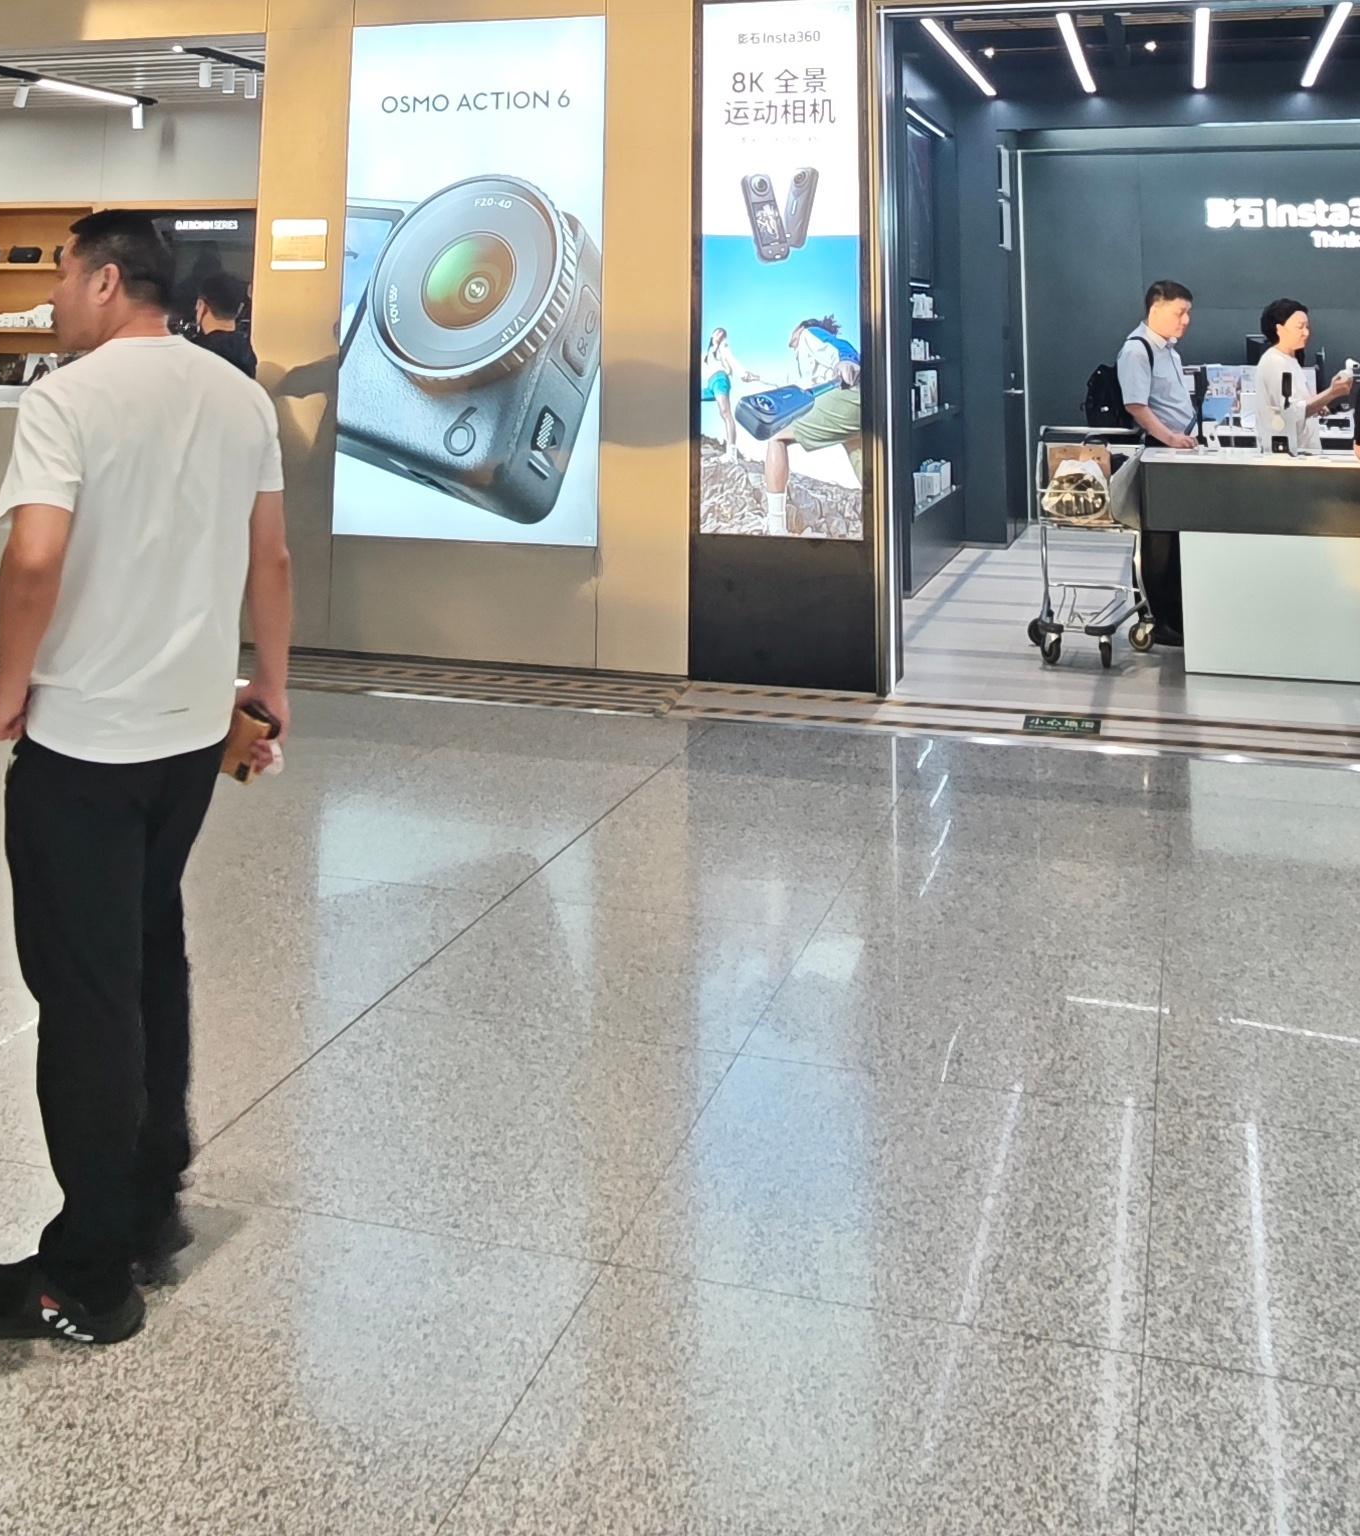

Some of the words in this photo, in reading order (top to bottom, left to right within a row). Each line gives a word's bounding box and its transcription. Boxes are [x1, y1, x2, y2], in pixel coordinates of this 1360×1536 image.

[732, 72, 764, 93] 8K
[775, 67, 827, 94] 全景
[381, 94, 449, 114] OSMO
[456, 90, 549, 111] ACTION
[557, 89, 571, 108] 6
[724, 98, 836, 126] 运动相机
[443, 406, 478, 456] 6
